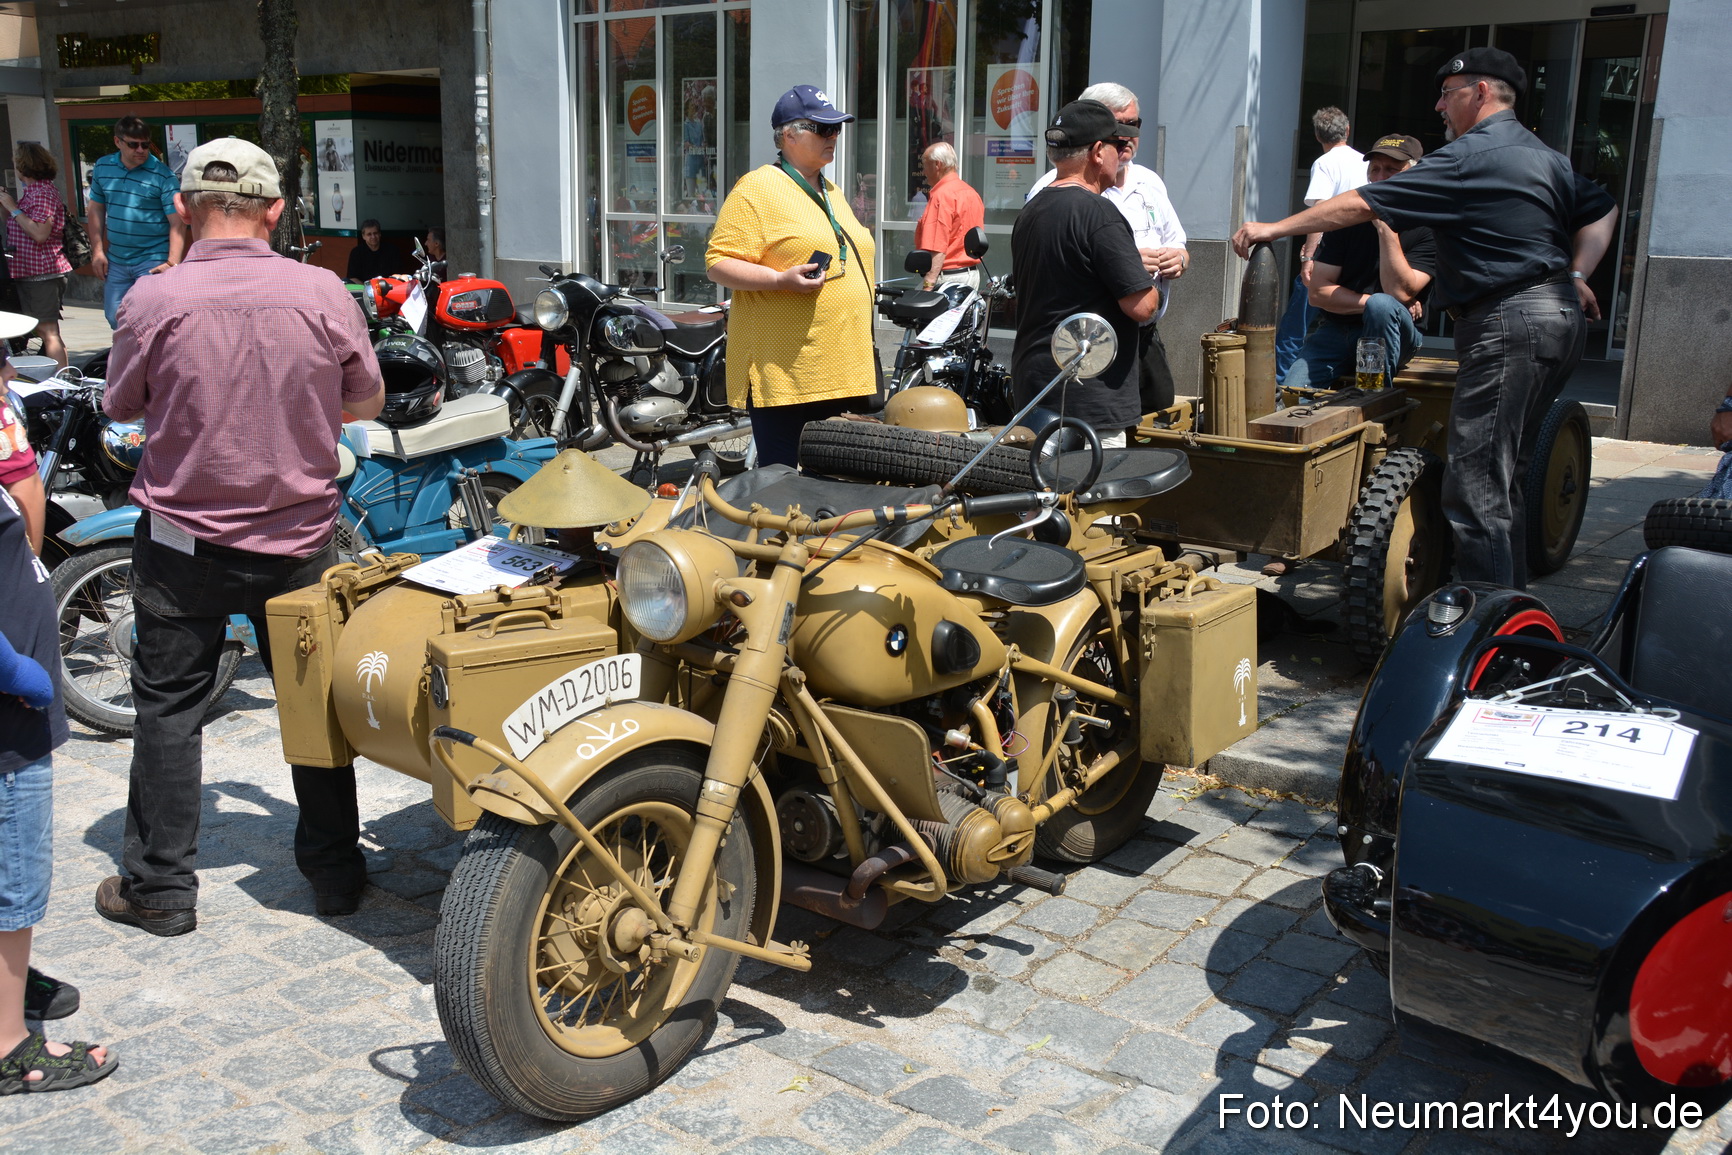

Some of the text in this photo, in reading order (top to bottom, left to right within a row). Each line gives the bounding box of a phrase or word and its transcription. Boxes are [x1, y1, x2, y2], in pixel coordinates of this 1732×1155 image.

[997, 83, 1025, 96] Sprechen
[996, 97, 1007, 105] wir
[1008, 92, 1021, 102] über
[501, 555, 544, 573] 563
[1561, 720, 1641, 744] 214
